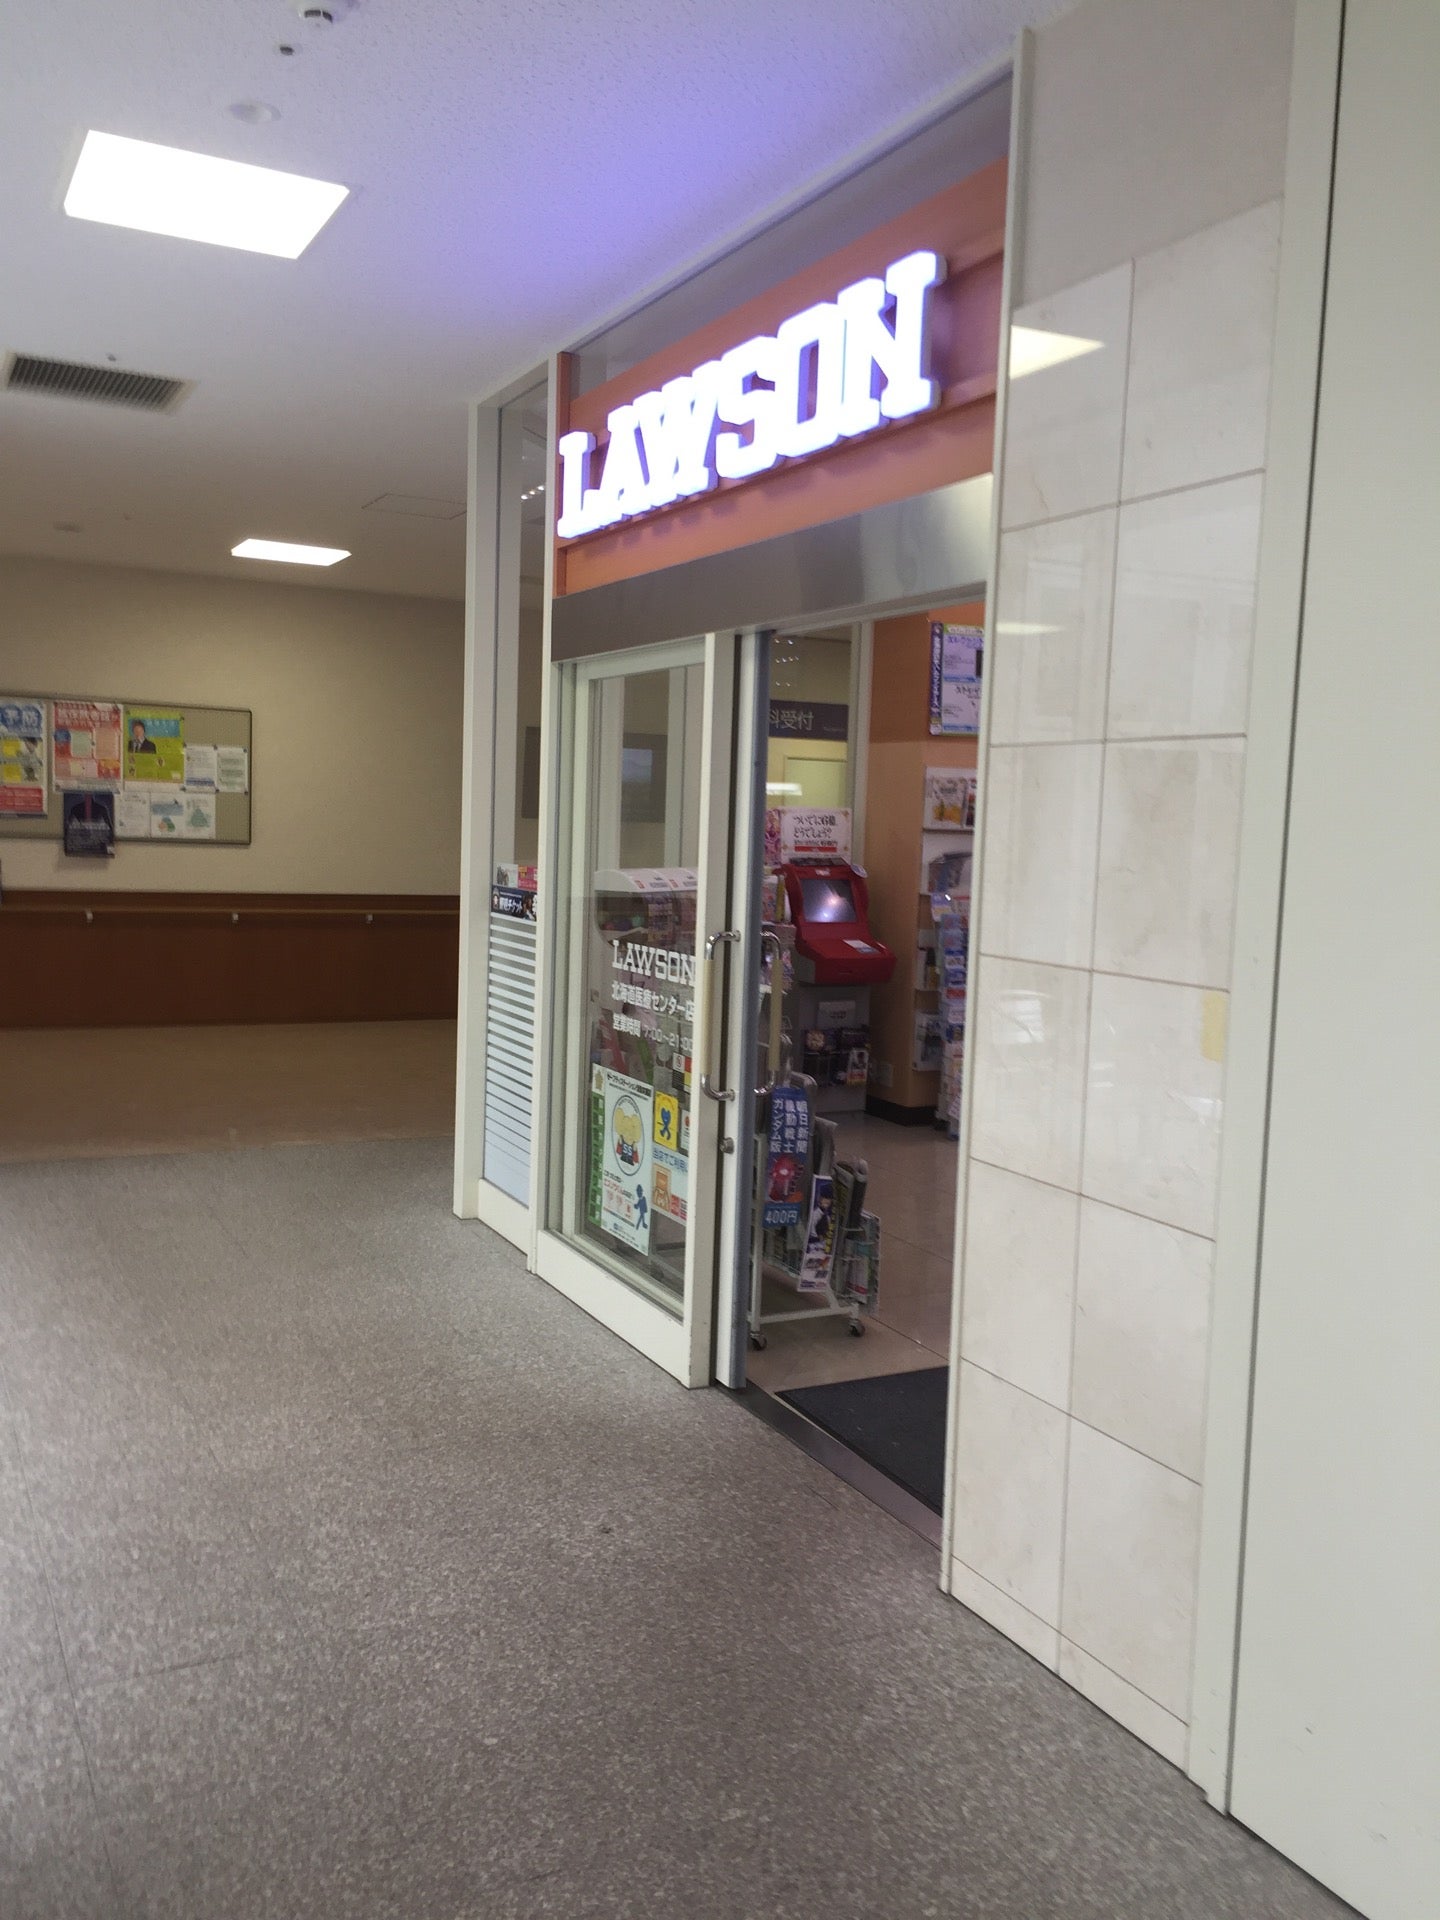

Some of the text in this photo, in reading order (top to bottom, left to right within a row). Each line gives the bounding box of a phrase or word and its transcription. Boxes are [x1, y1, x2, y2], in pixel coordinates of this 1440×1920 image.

[557, 250, 947, 538] LAWSON
[612, 939, 696, 988] LAWSON
[769, 1098, 784, 1154] ガンダム版
[784, 1099, 797, 1154] 機動戦士
[796, 1099, 809, 1154] 朝日新聞
[764, 1209, 798, 1225] 400円
